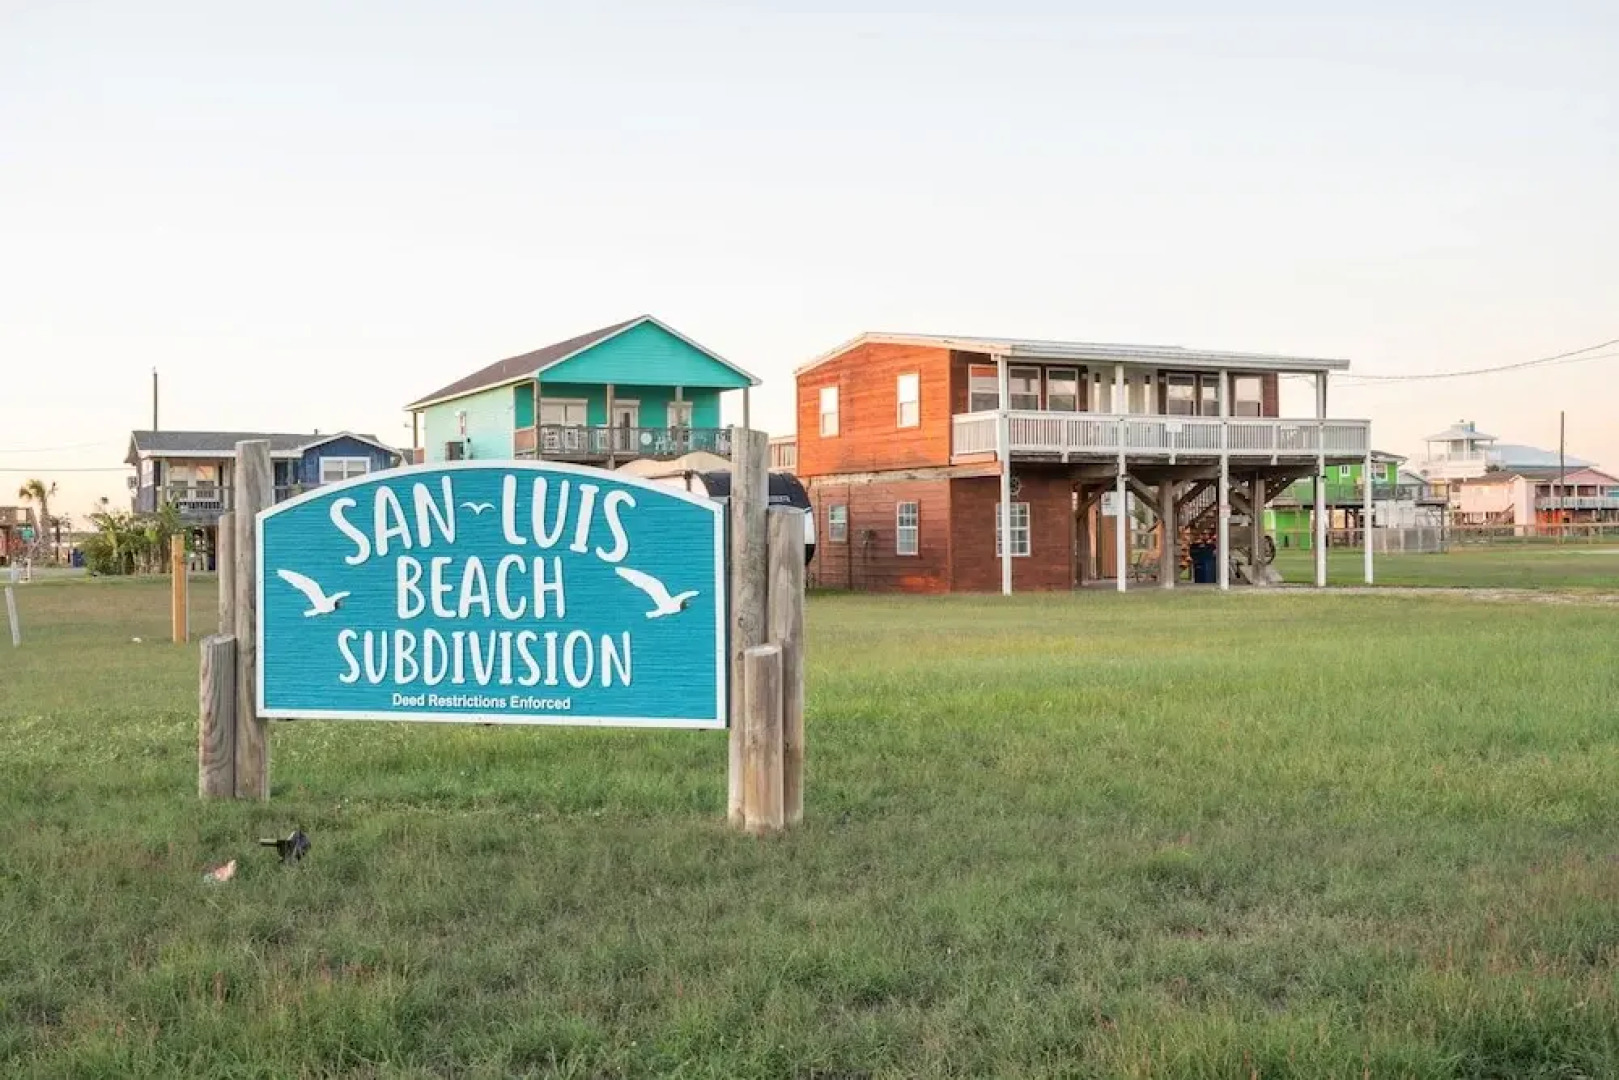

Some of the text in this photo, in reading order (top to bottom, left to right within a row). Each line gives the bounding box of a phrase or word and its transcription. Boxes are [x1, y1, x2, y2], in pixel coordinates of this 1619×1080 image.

[329, 474, 637, 566] SAN LUIS
[396, 554, 566, 620] BEACH
[337, 629, 632, 688] SUBDIVISION
[392, 693, 571, 710] Deed Restrictions Enforced
